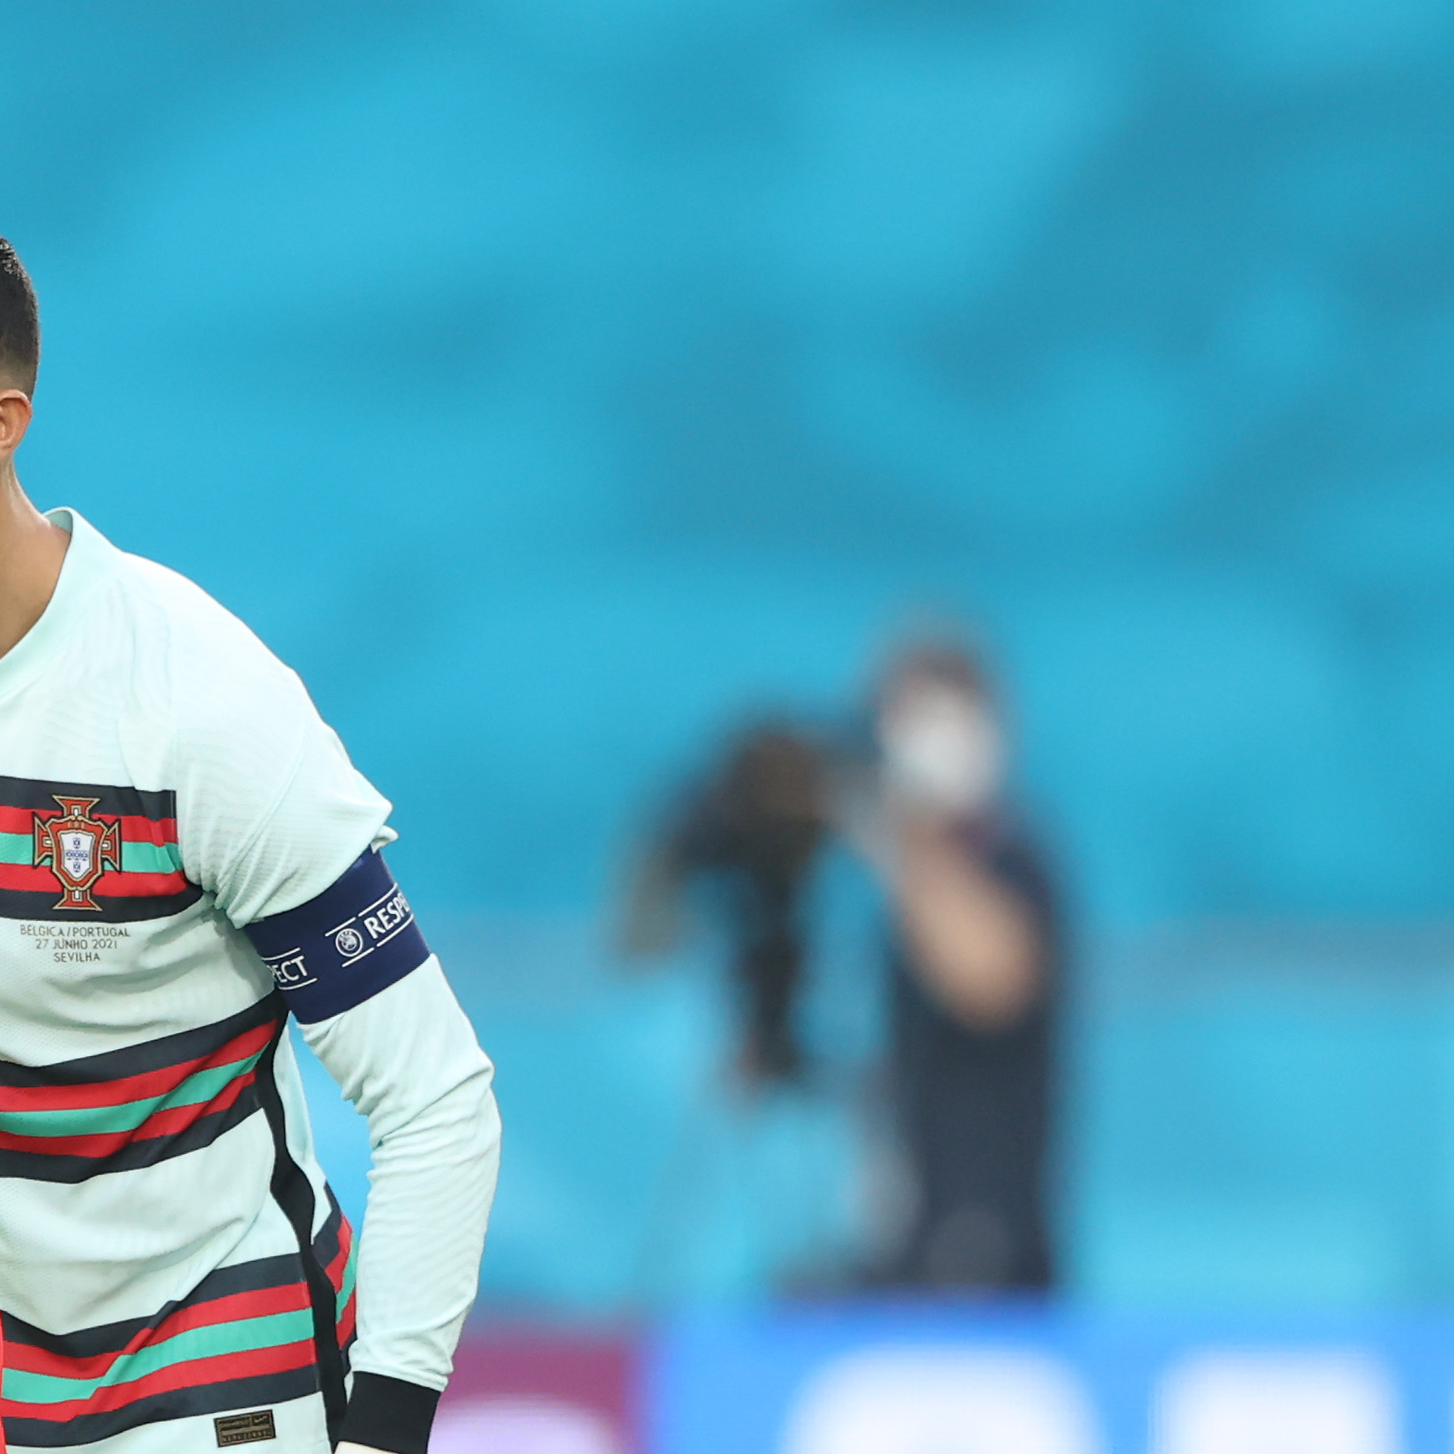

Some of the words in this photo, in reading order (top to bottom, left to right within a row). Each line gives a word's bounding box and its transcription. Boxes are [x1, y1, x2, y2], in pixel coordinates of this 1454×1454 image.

[35, 938, 49, 949] 27
[52, 938, 88, 950] JUNHO
[92, 938, 118, 949] 2021
[53, 952, 101, 963] SEVILHA
